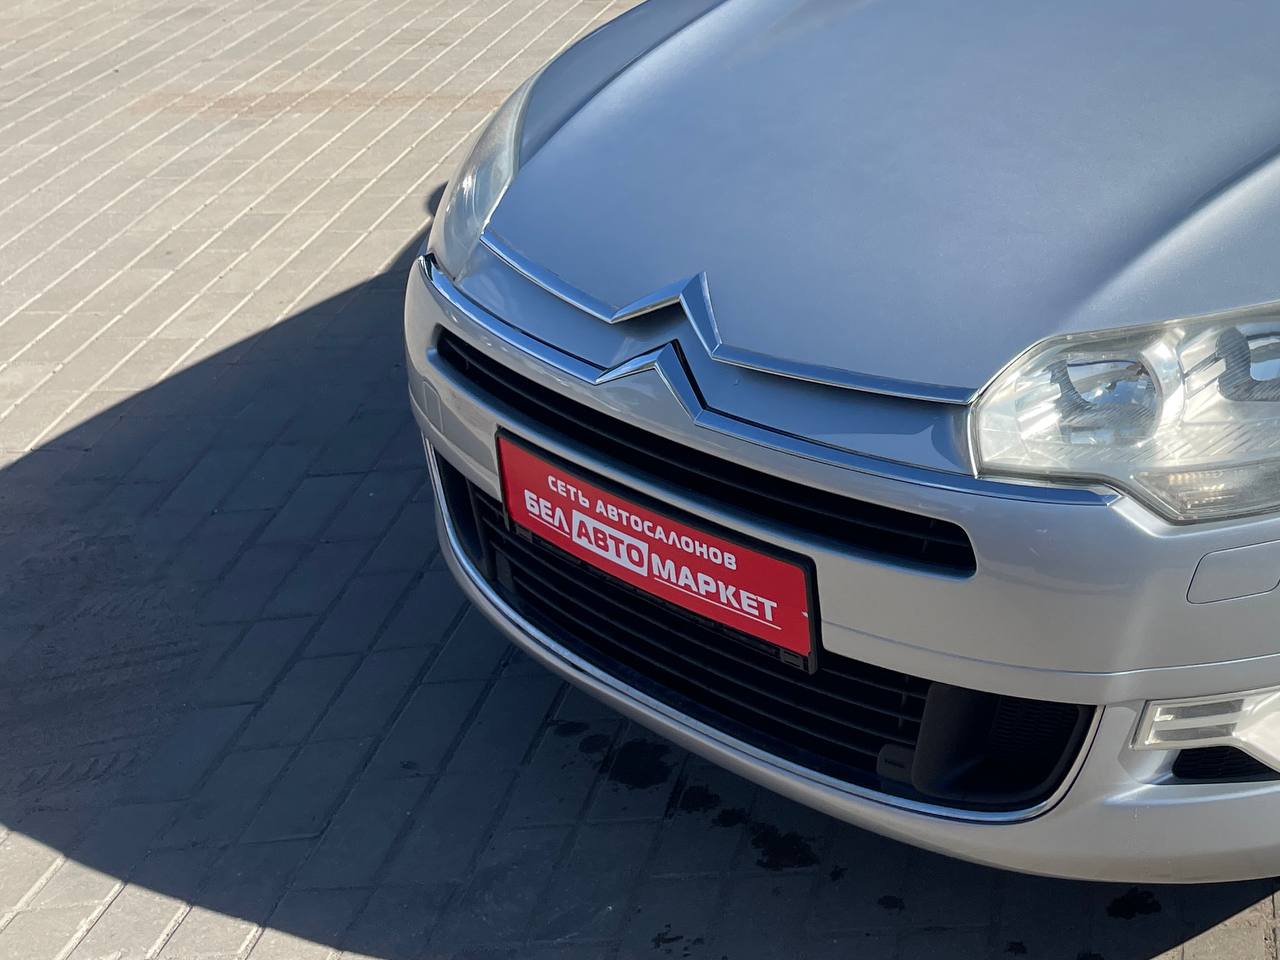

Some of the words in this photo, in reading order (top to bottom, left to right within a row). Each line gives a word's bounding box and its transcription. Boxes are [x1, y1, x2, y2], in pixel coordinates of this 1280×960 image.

[524, 488, 571, 534] БЕЛ
[576, 517, 645, 569] АВТО
[651, 553, 778, 622] МАРКЕТ
[547, 474, 590, 508] СЕТЬ
[596, 499, 737, 570] АВТОСАЛОНОВ
